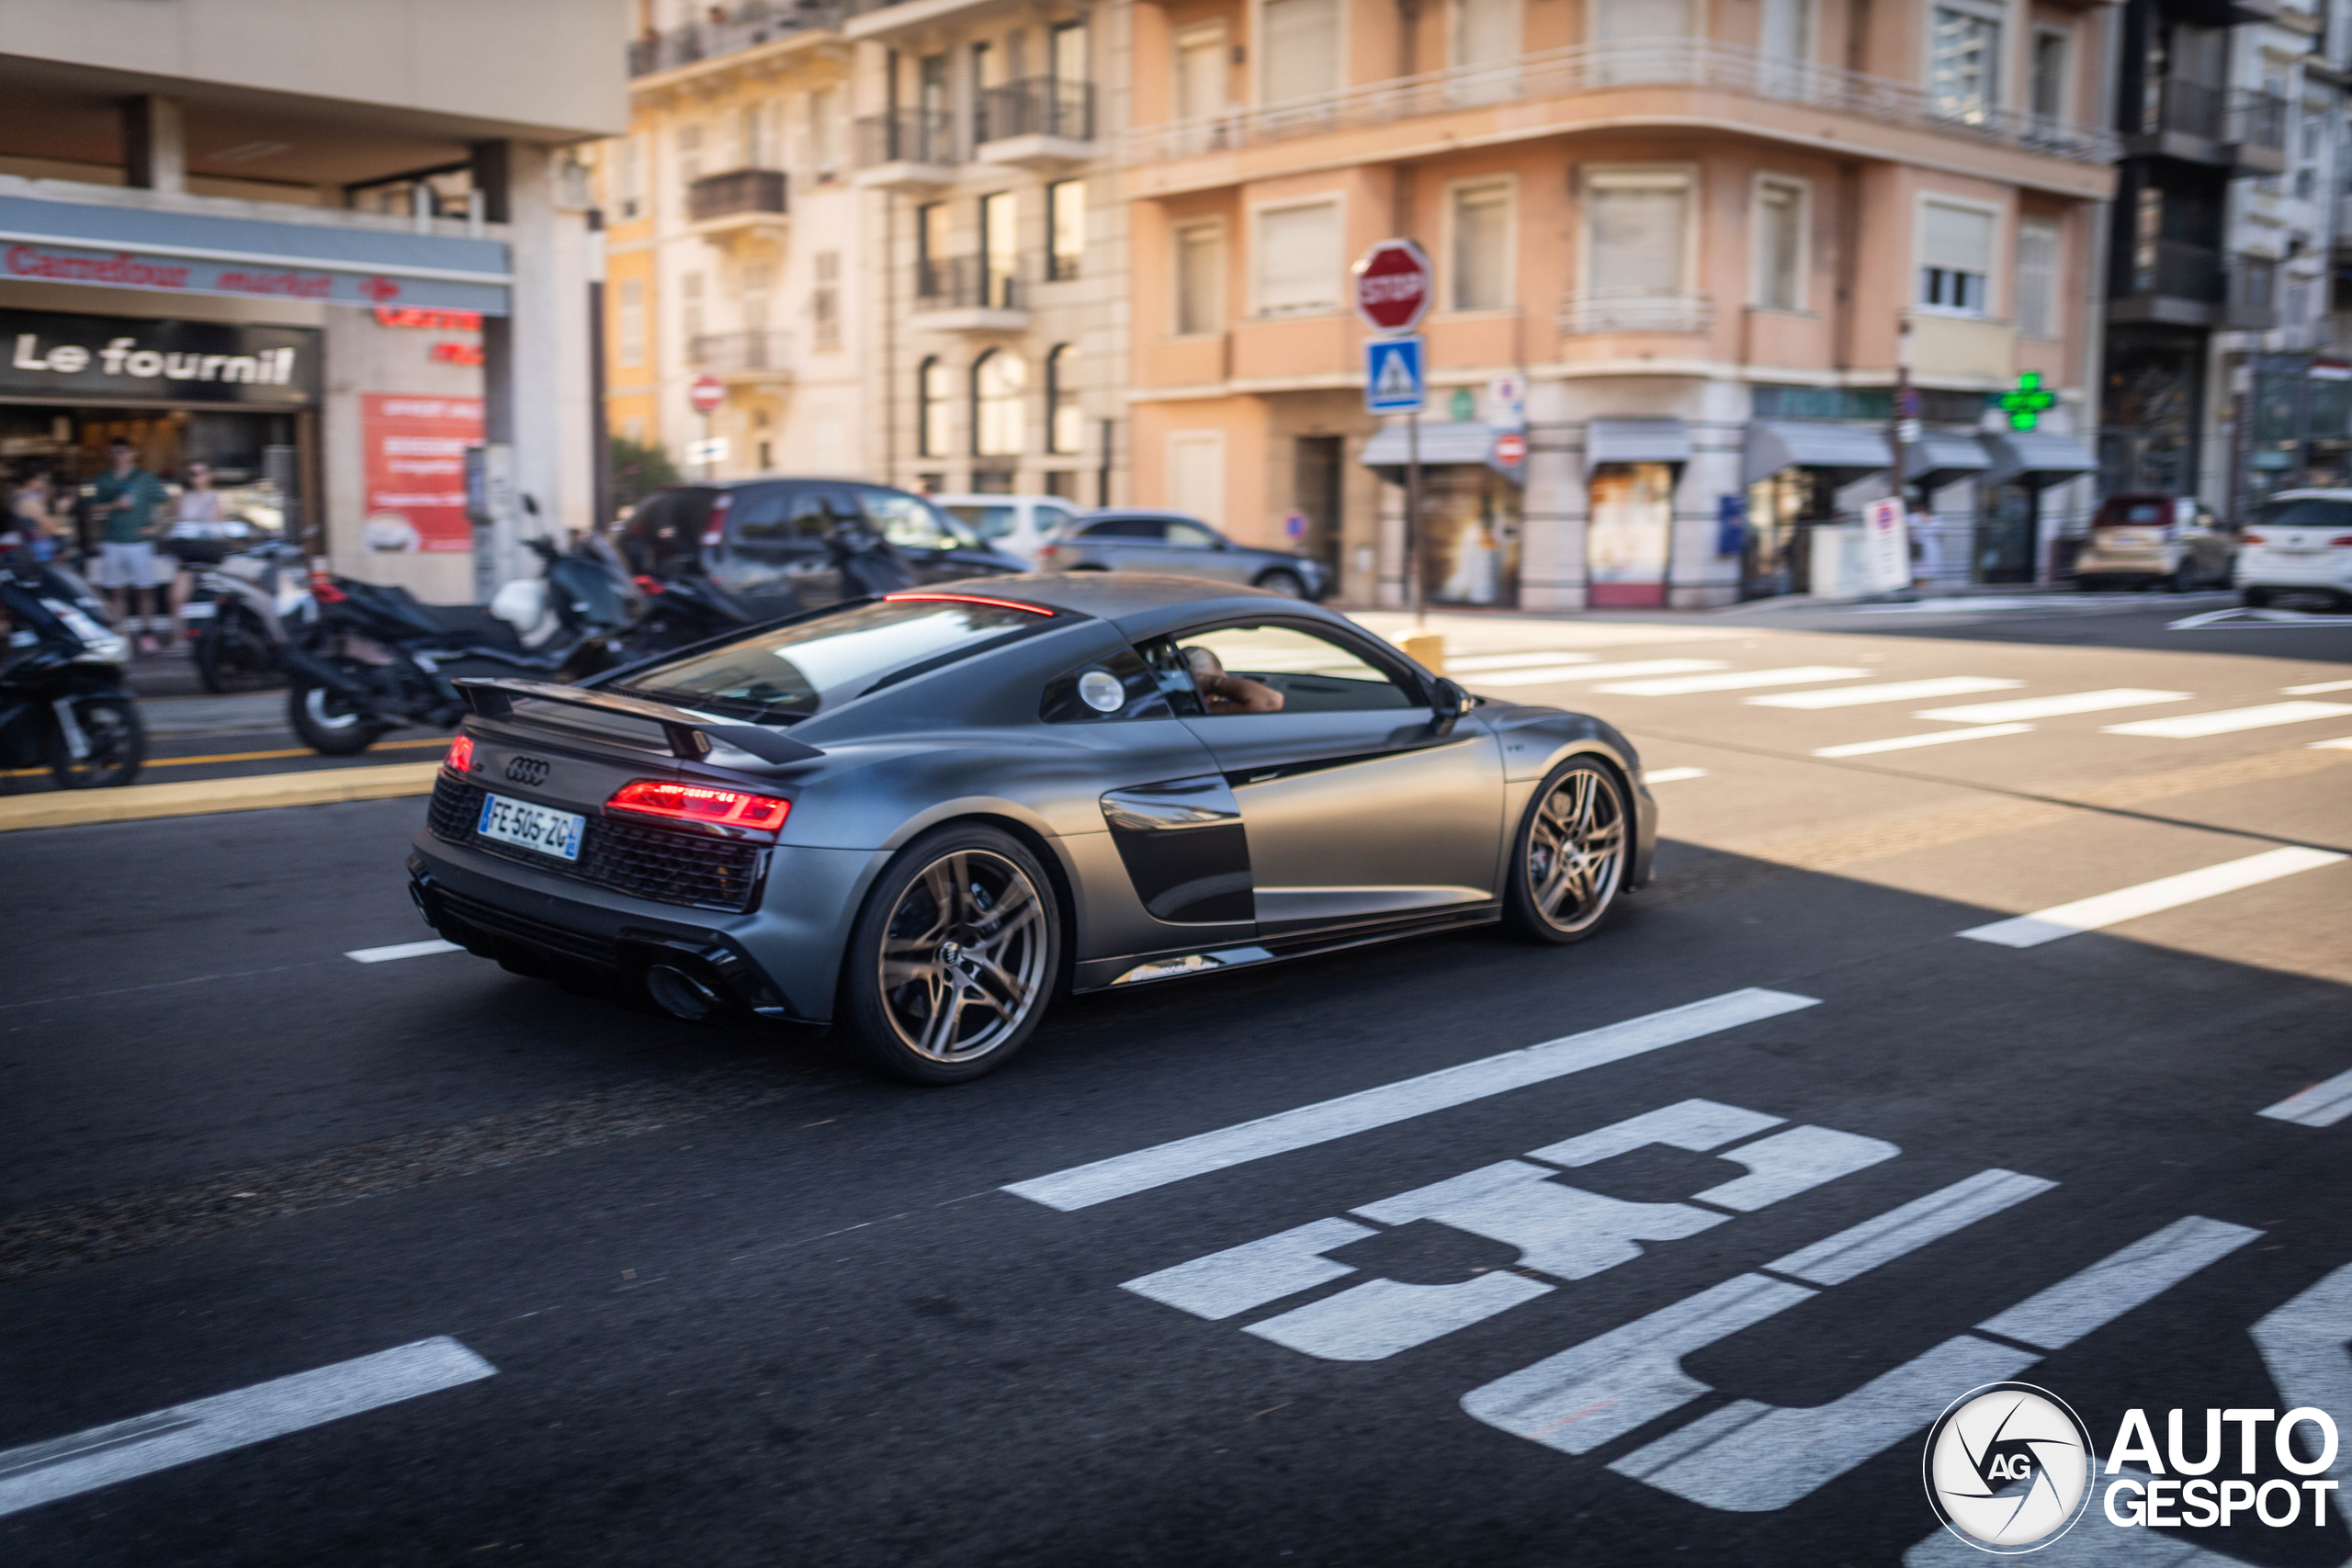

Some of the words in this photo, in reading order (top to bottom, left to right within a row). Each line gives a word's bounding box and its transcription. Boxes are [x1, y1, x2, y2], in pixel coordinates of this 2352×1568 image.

[1362, 274, 1423, 302] STOP
[13, 333, 90, 373] Le
[98, 337, 295, 386] fournil
